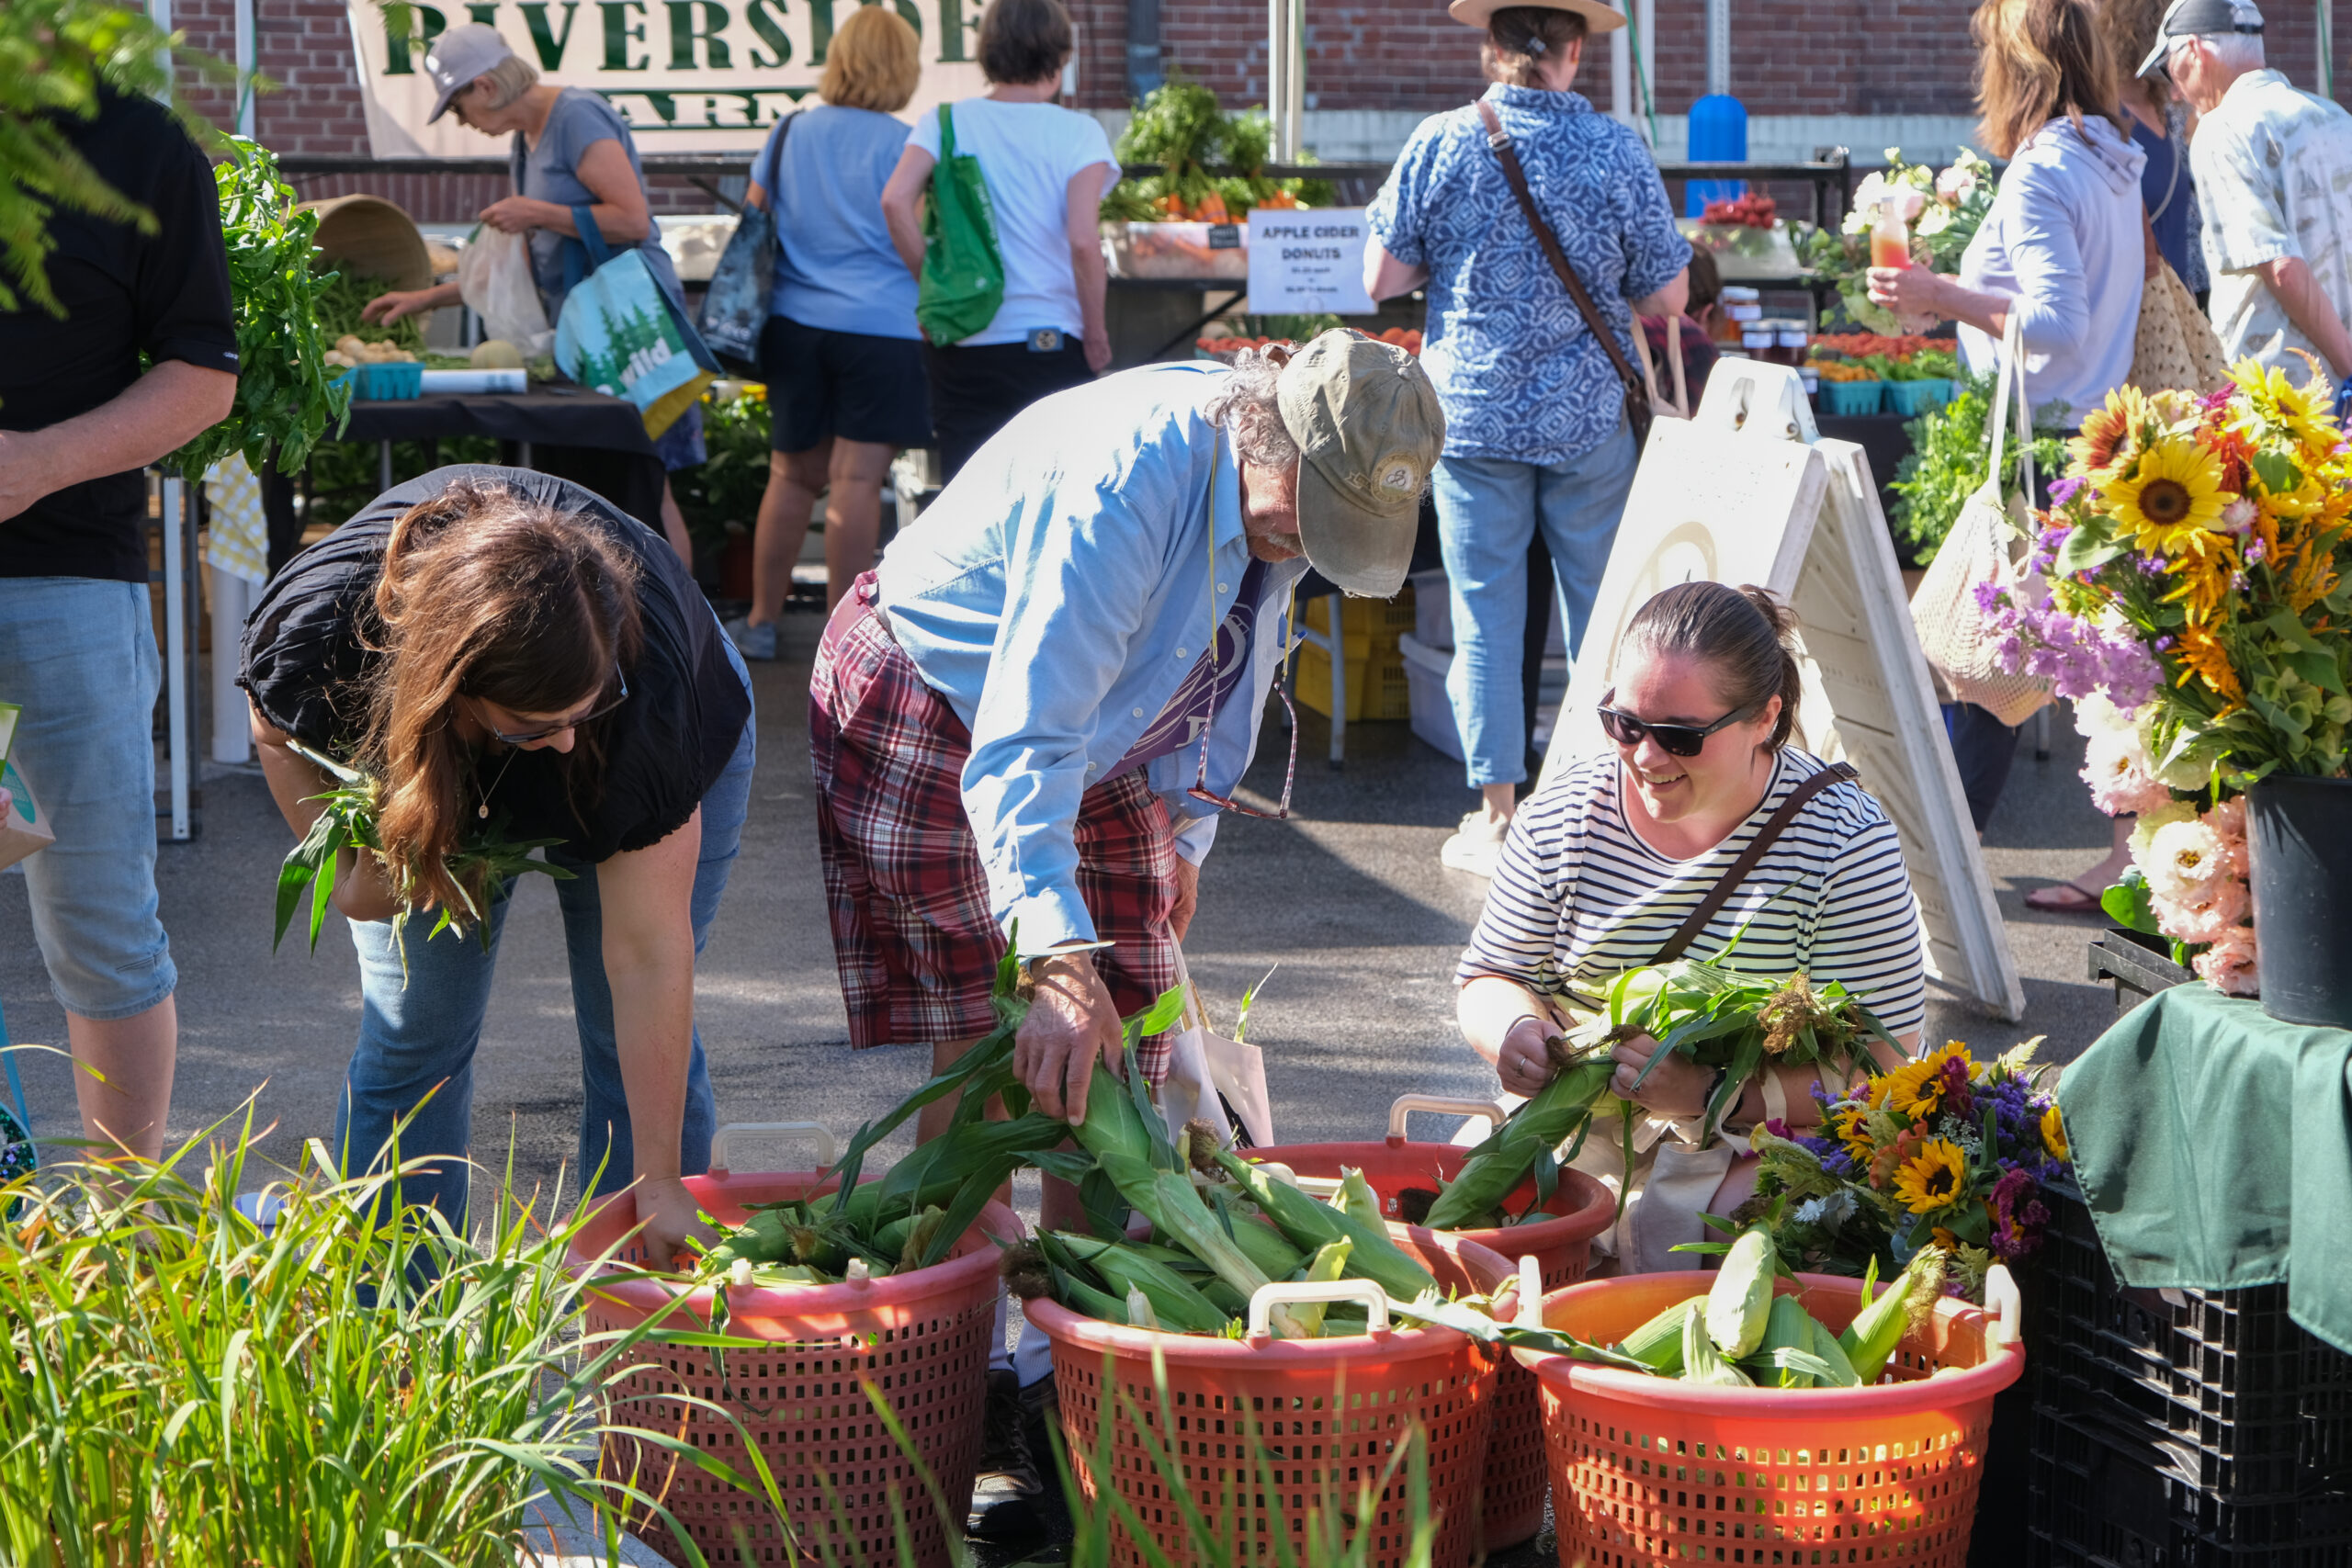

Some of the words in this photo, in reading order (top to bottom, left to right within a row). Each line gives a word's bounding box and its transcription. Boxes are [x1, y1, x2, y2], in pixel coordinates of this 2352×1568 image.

[608, 93, 820, 126] ARM
[1262, 226, 1309, 238] APPLE
[1314, 226, 1359, 238] CIDER
[1282, 248, 1340, 259] DONUTS
[618, 336, 672, 388] wild
